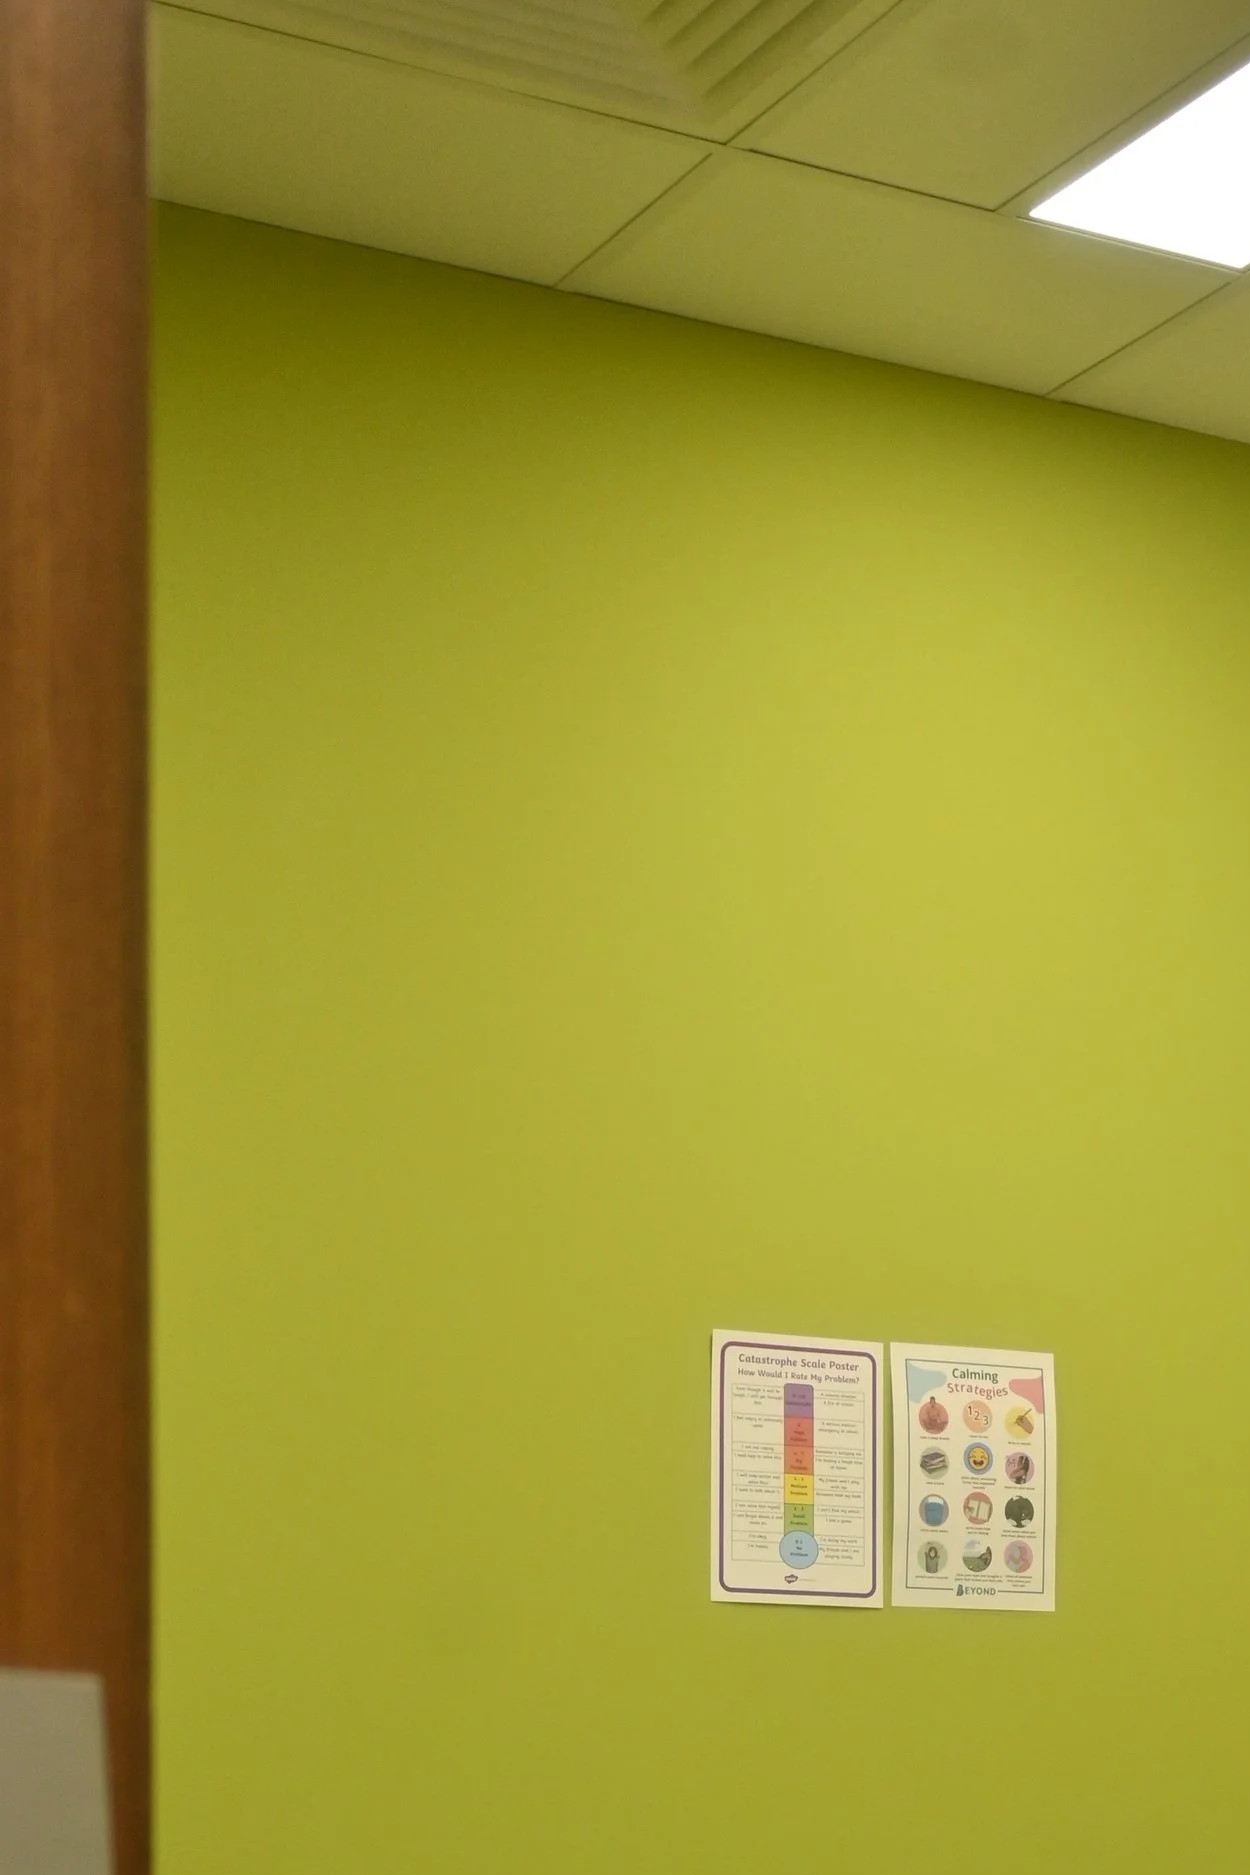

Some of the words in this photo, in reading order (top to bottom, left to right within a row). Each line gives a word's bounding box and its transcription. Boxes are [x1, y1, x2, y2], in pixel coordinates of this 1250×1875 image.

[738, 1353, 797, 1368] Catastrophe
[800, 1358, 826, 1369] Scale
[829, 1361, 859, 1371] Poster
[737, 1368, 755, 1376] How
[757, 1369, 782, 1378] Would
[791, 1372, 808, 1380] Rate
[811, 1374, 822, 1383] My
[825, 1375, 860, 1384] Problem?
[952, 1368, 999, 1384] Calming
[947, 1382, 1008, 1400] Strategies
[967, 1405, 973, 1416] 1
[974, 1410, 981, 1421] 2
[983, 1415, 989, 1426] 3
[956, 1583, 997, 1596] BEYOND
